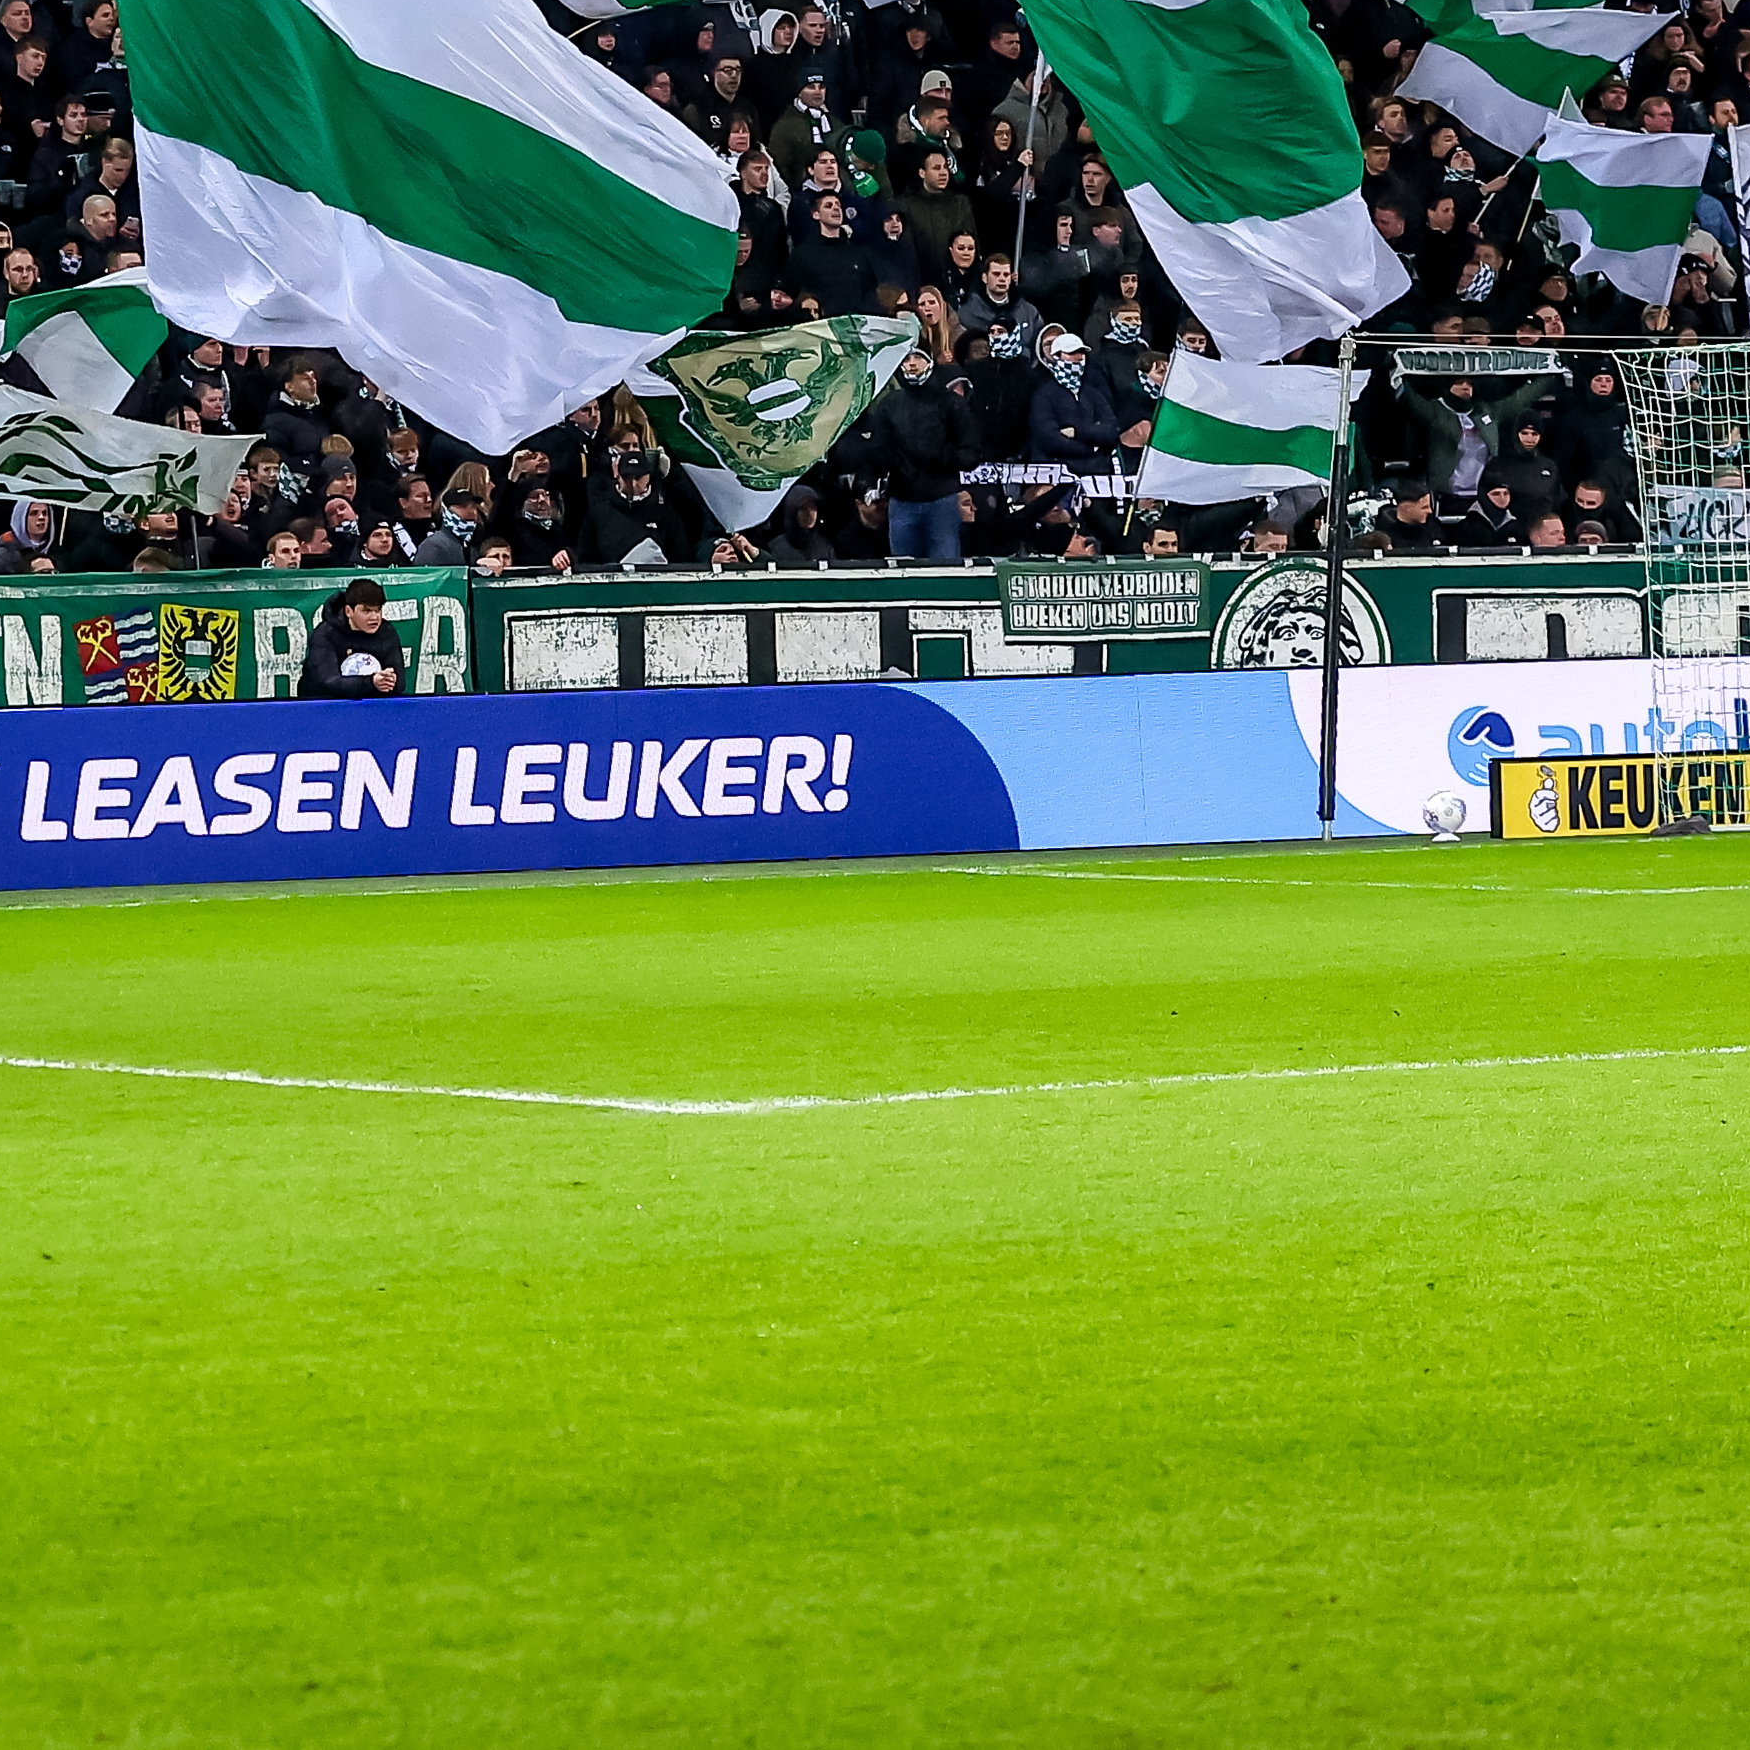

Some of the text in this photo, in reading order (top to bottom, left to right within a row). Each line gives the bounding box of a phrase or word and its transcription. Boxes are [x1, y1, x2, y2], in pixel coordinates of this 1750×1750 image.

[1012, 600, 1198, 628] BREKEN ONS NOOIT
[20, 747, 419, 842] LEASEN
[450, 733, 854, 826] LEUKER!
